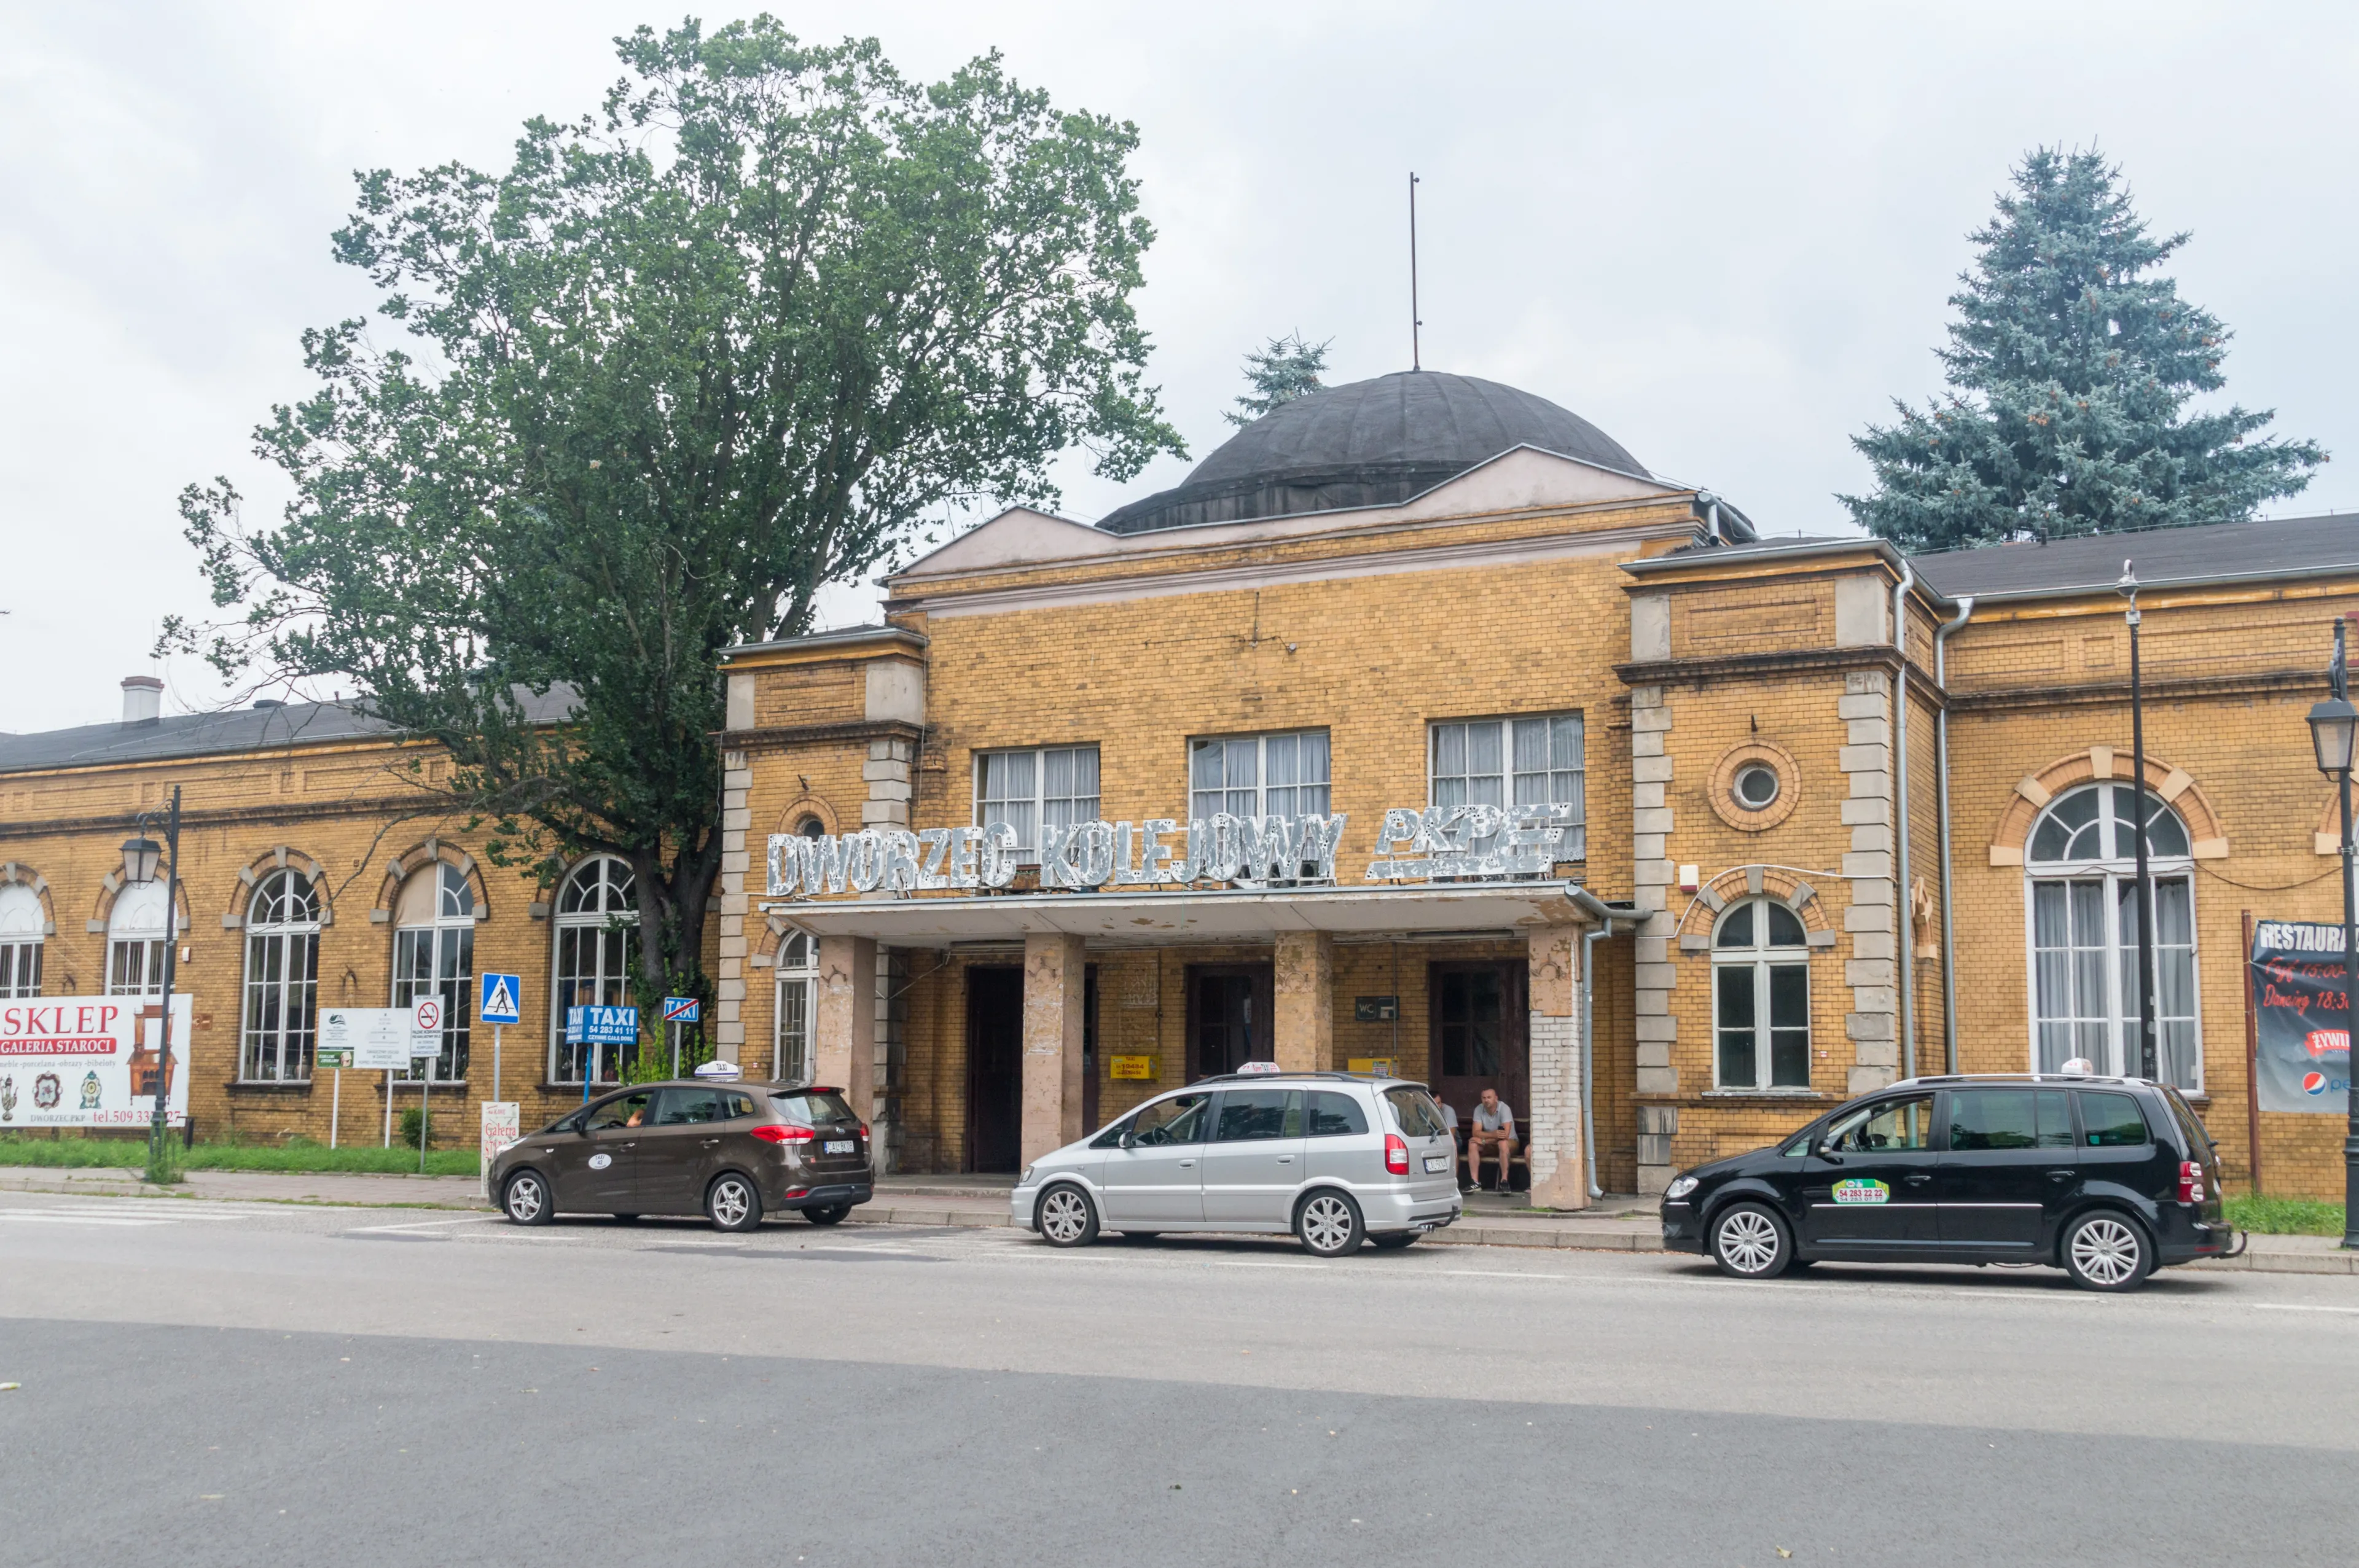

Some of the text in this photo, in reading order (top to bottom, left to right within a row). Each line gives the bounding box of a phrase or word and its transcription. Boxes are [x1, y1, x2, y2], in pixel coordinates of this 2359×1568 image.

[767, 822, 1017, 897] DWORZEC
[1041, 813, 1348, 888] KOLEJOWY
[2260, 923, 2359, 952] RESTAURA
[667, 1000, 696, 1018] TAXI
[1358, 1003, 1374, 1013] WC
[2263, 983, 2309, 1016] Dancing
[4, 1005, 119, 1036] SKLEP
[569, 1007, 584, 1026] TAXI
[590, 1007, 635, 1026] TAXI
[1, 1039, 111, 1053] GALERIA STAROCI
[485, 1123, 516, 1136] Galeria
